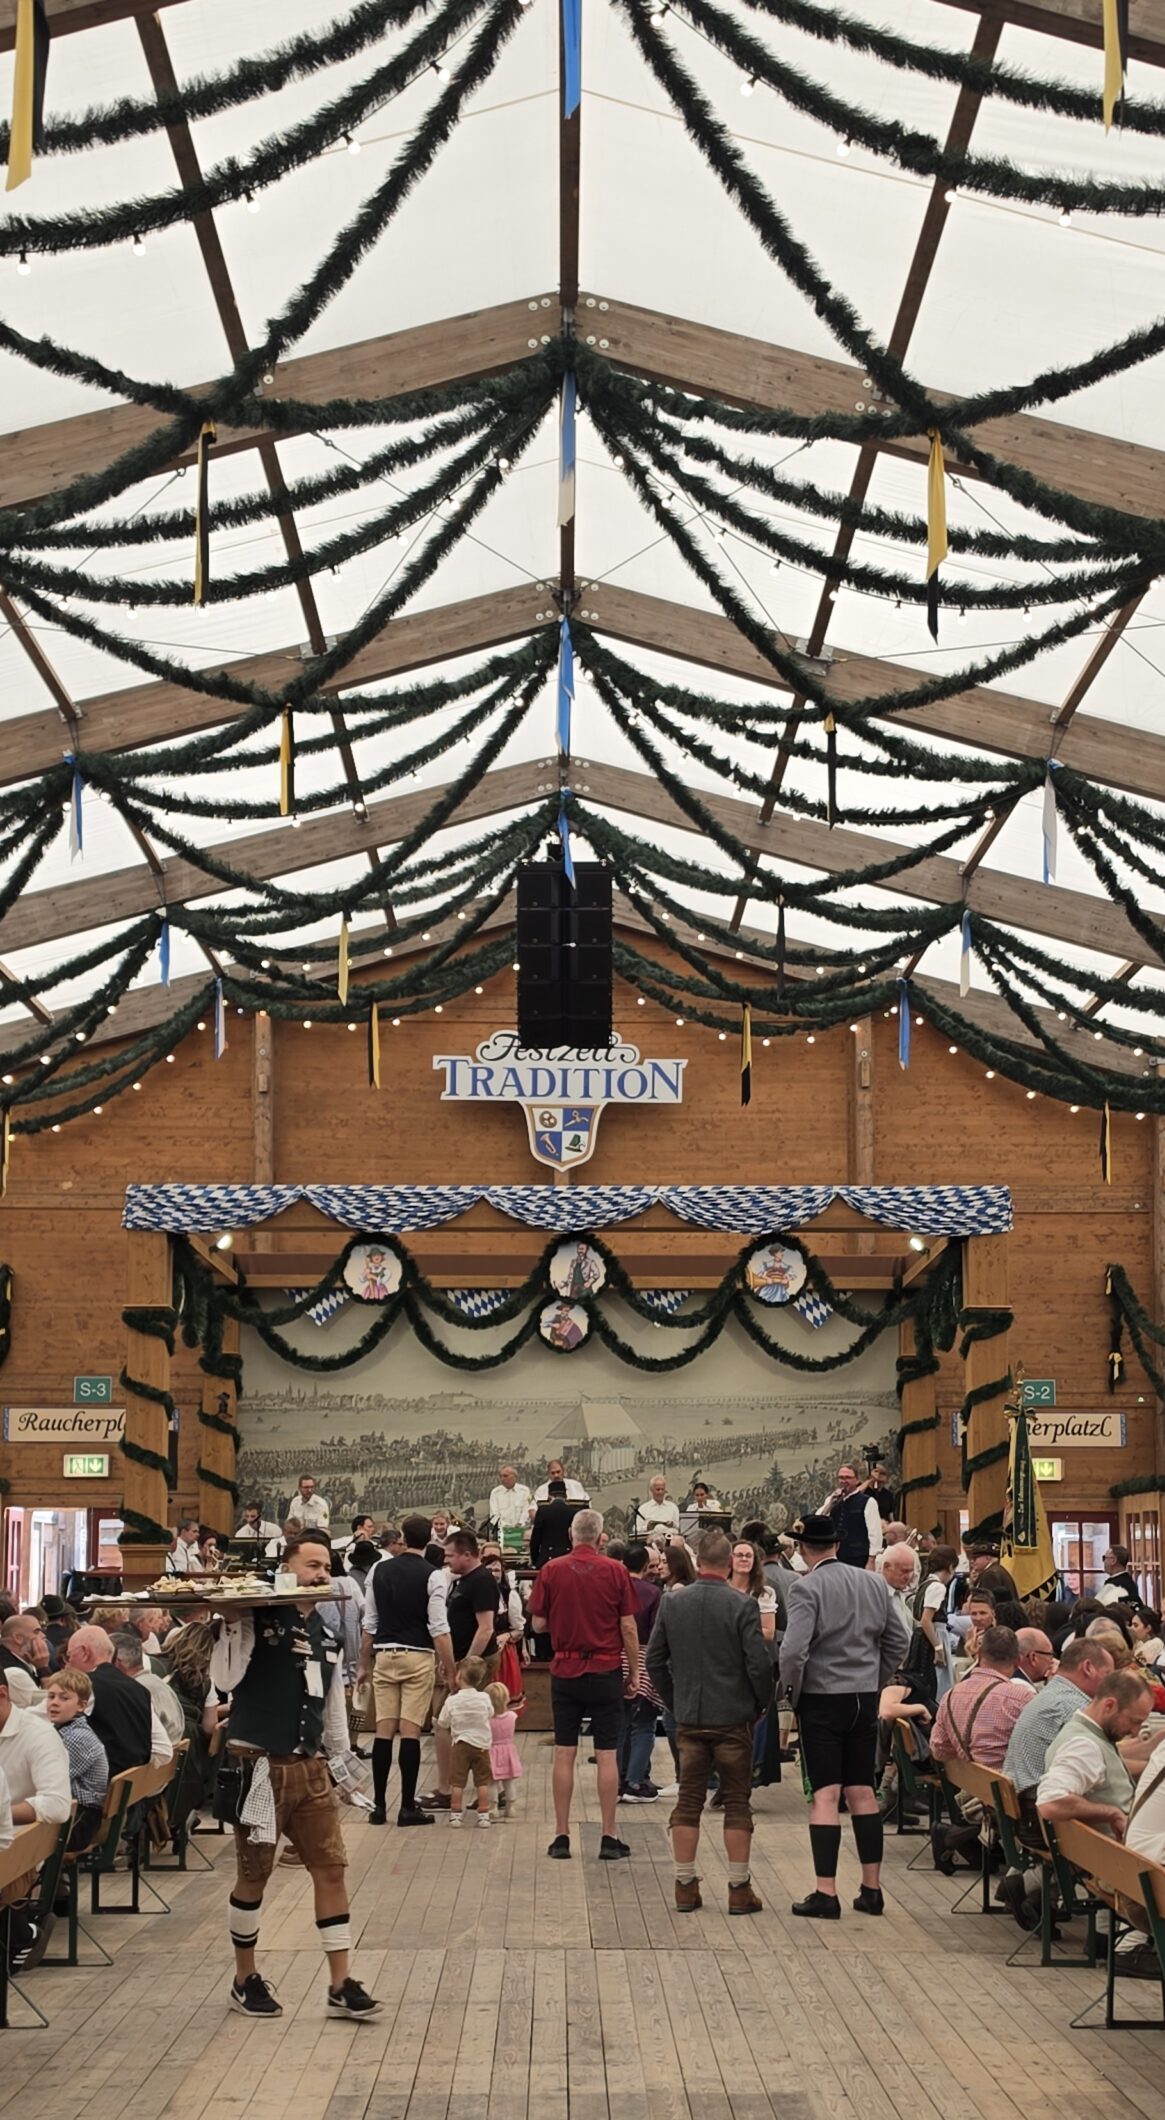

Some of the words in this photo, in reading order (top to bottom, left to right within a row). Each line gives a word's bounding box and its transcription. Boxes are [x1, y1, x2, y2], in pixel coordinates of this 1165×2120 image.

[437, 1058, 682, 1100] TRADITION
[80, 1382, 106, 1397] S-3
[1024, 1385, 1051, 1400] S-2
[17, 1410, 126, 1439] Raucherpl
